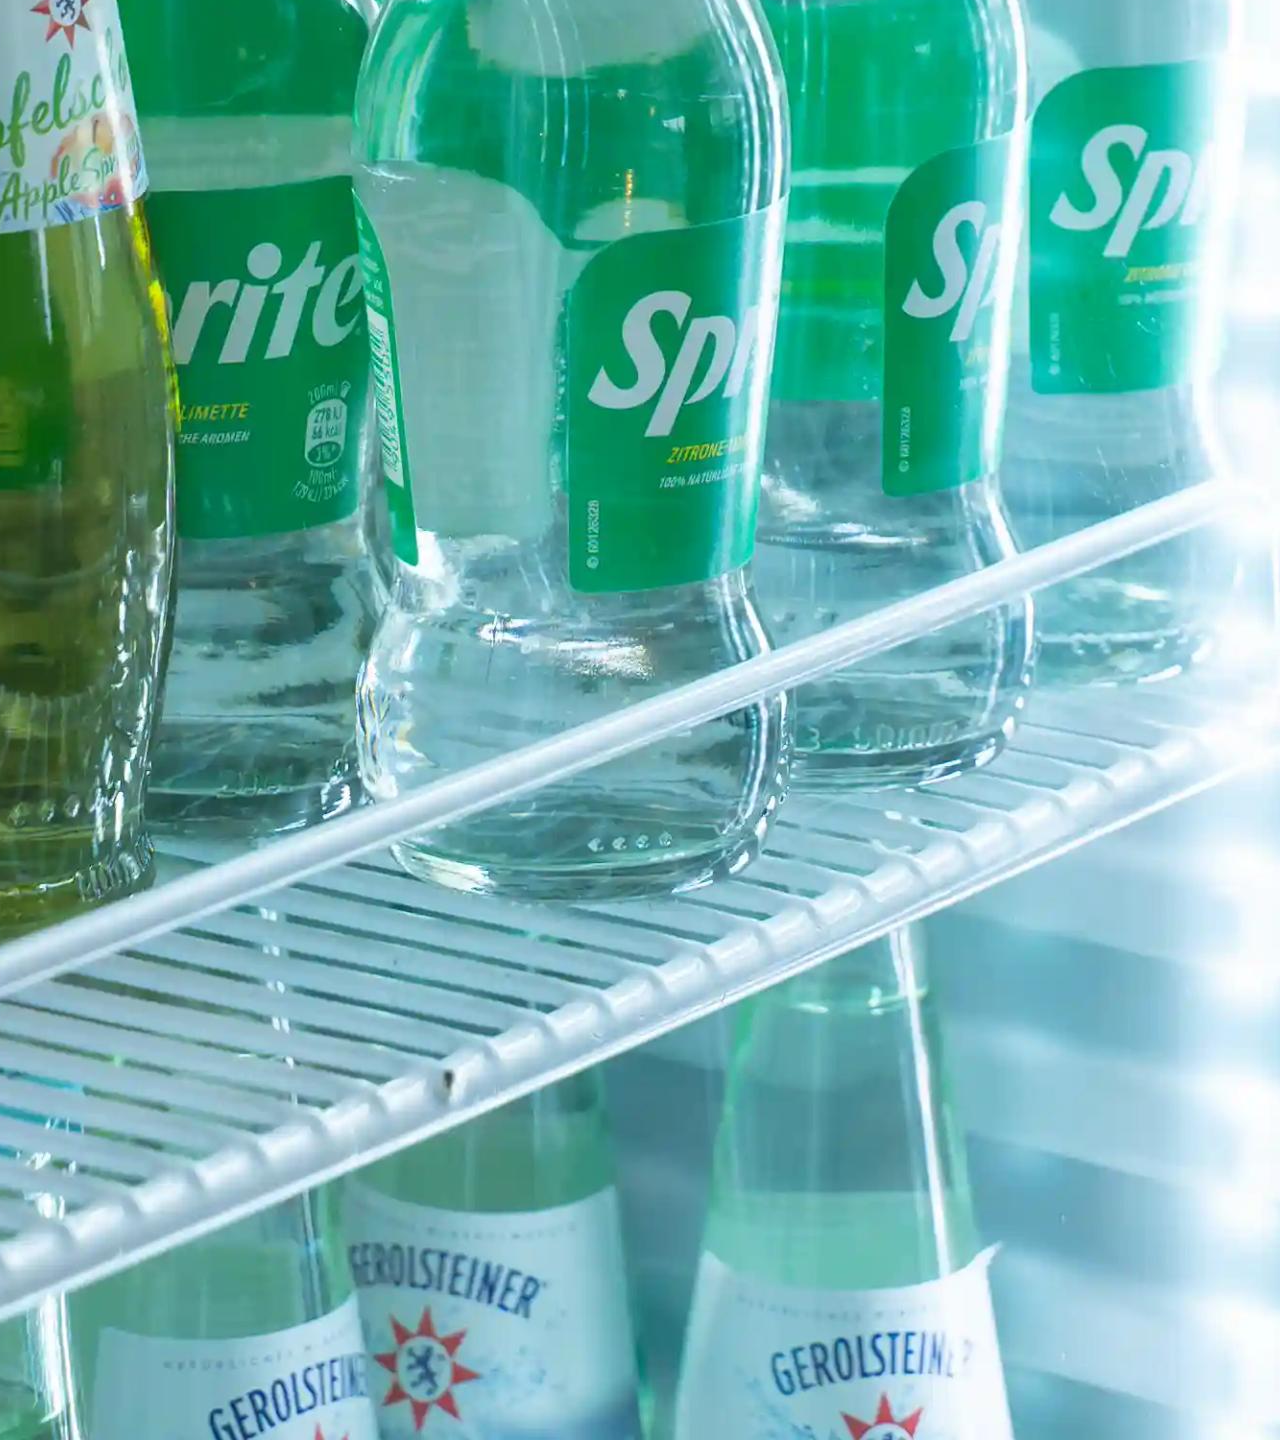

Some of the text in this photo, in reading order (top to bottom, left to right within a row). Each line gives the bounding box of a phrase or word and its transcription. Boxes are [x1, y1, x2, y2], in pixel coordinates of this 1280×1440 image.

[169, 240, 369, 366] rite
[180, 402, 250, 421] LIMETTE
[200, 430, 250, 444] AROMEN
